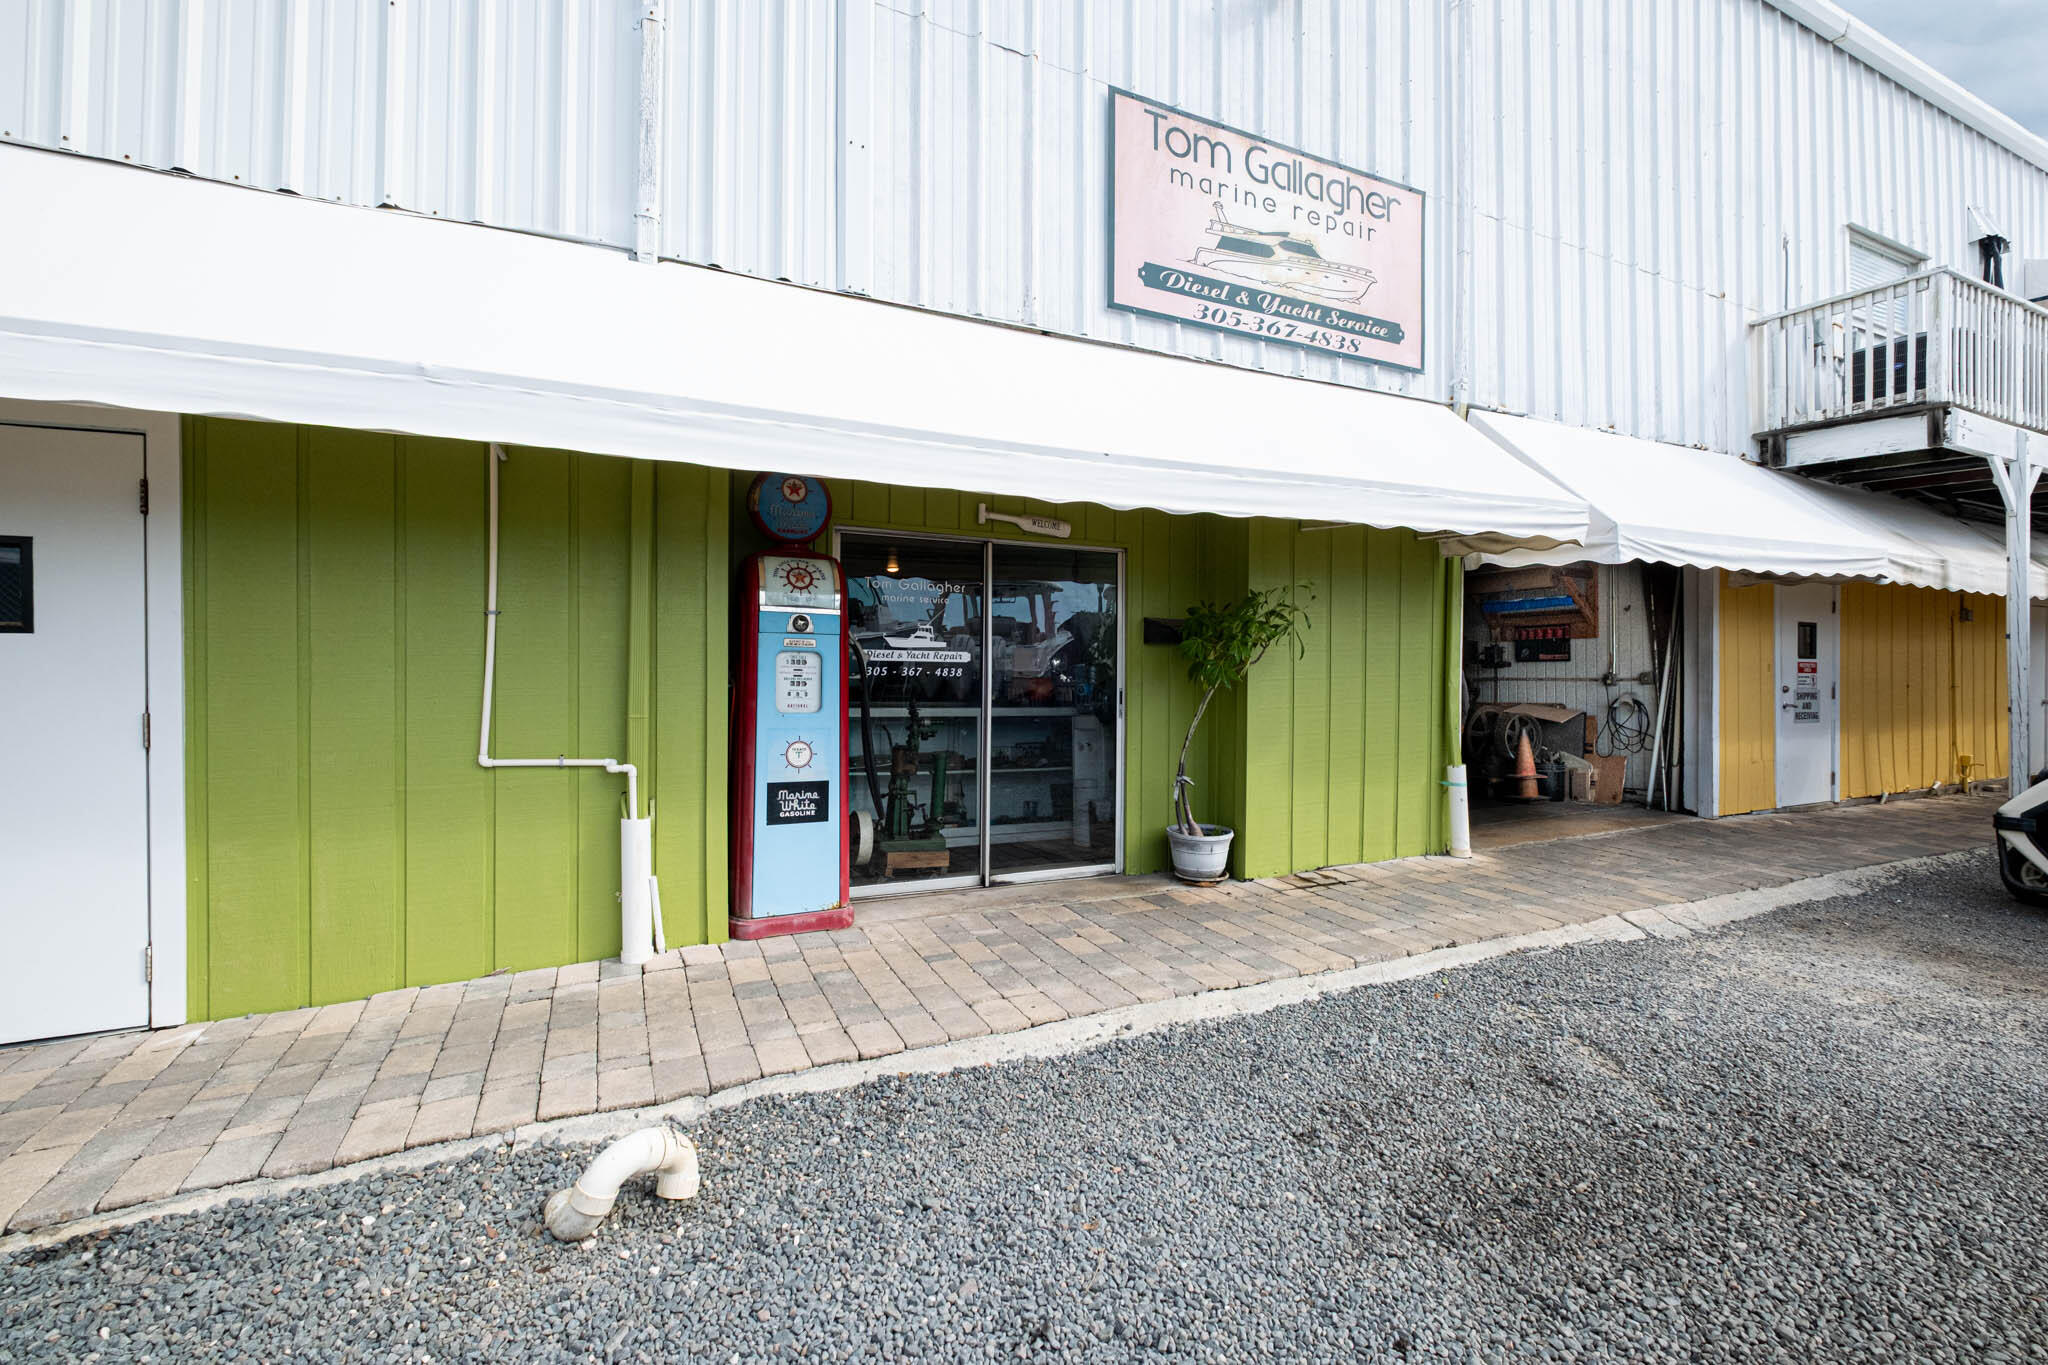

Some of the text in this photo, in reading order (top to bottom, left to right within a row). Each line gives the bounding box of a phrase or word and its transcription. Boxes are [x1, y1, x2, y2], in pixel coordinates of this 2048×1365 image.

[1144, 108, 1402, 222] Tom Gallagher
[1171, 168, 1376, 241] marine repair
[1160, 270, 1389, 338] Diesel & Yacht Service
[1193, 304, 1361, 353] 305-367-4838
[864, 576, 966, 595] Tom Gallagher
[881, 594, 950, 604] marine service
[866, 650, 895, 659] Diesel
[905, 650, 931, 659] Yacht
[933, 651, 963, 661] Repair
[866, 666, 888, 676] 305
[901, 666, 922, 676] 367
[935, 667, 963, 677] 4838
[777, 790, 820, 800] Marine
[779, 799, 817, 811] White
[779, 810, 816, 818] GASOLINE
